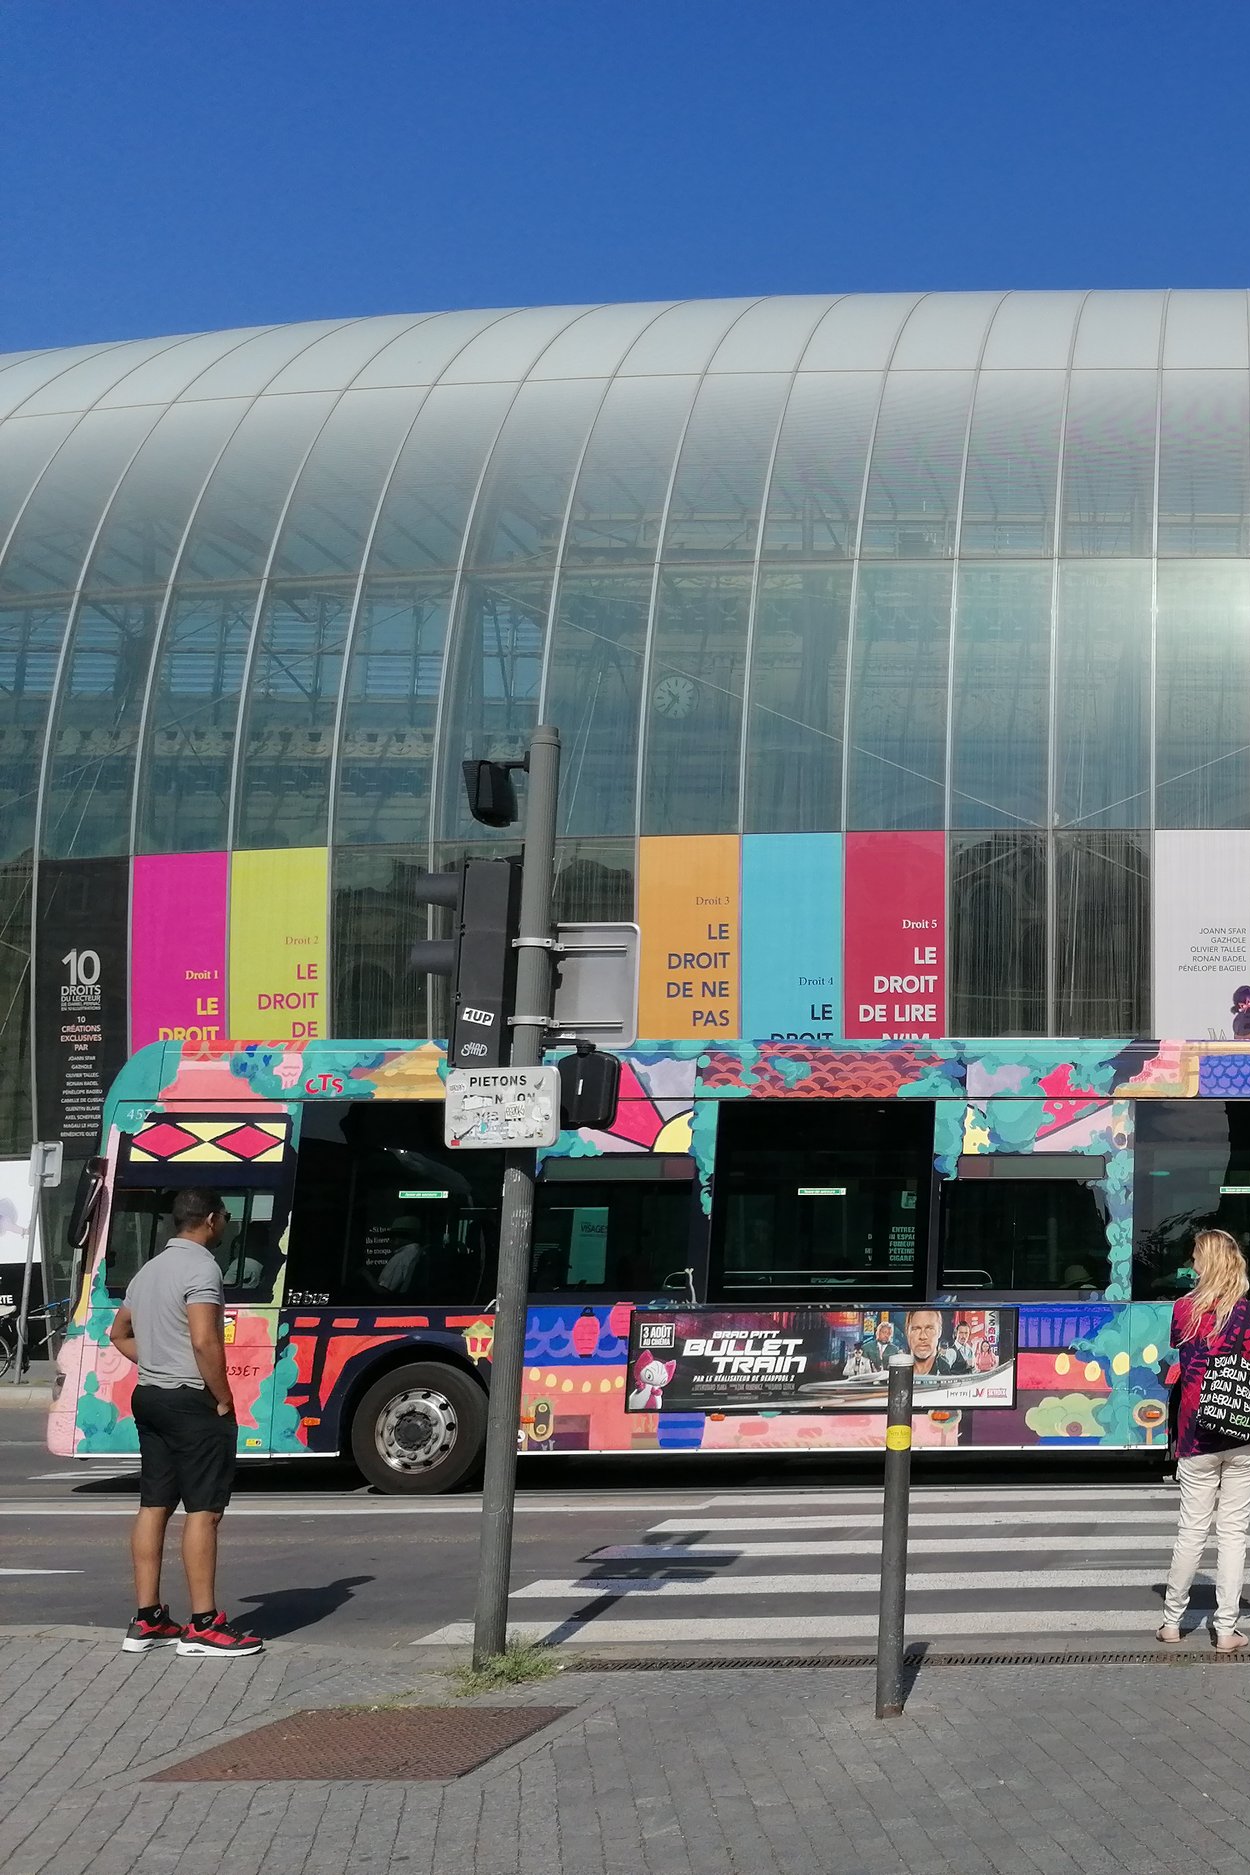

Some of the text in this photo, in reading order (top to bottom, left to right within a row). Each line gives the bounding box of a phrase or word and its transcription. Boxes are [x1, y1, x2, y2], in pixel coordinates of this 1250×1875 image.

[696, 896, 730, 906] Droit 3
[708, 923, 730, 940] LE
[902, 919, 938, 929] Droit 5
[285, 936, 319, 946] Droit 2
[668, 952, 730, 969] DROIT
[914, 946, 937, 965] LE
[61, 949, 101, 985] 10
[185, 970, 219, 981] Droit 1
[296, 963, 318, 980] LE
[667, 981, 730, 998] DE NE
[798, 976, 834, 986] Droit 4
[873, 975, 938, 994] DROIT
[61, 985, 101, 996] DROITS
[196, 997, 219, 1016] LE
[257, 992, 319, 1010] DROIT
[465, 1009, 492, 1023] 1UP
[692, 1009, 730, 1027] PAS
[811, 1003, 833, 1021] LE
[859, 1004, 937, 1022] DE LIRE
[60, 1034, 102, 1042] EXCLUSIVES
[292, 1021, 318, 1038] DE
[469, 1075, 527, 1087] PIETONS
[127, 1109, 153, 1120] 457
[643, 1325, 672, 1338] 3 AOÛT
[712, 1330, 780, 1339] BRAD PITT
[643, 1338, 670, 1346] AU CINÉMA
[682, 1338, 804, 1356] BULLET
[712, 1356, 807, 1374] TRAIN
[1211, 1393, 1242, 1410] BERLIN
